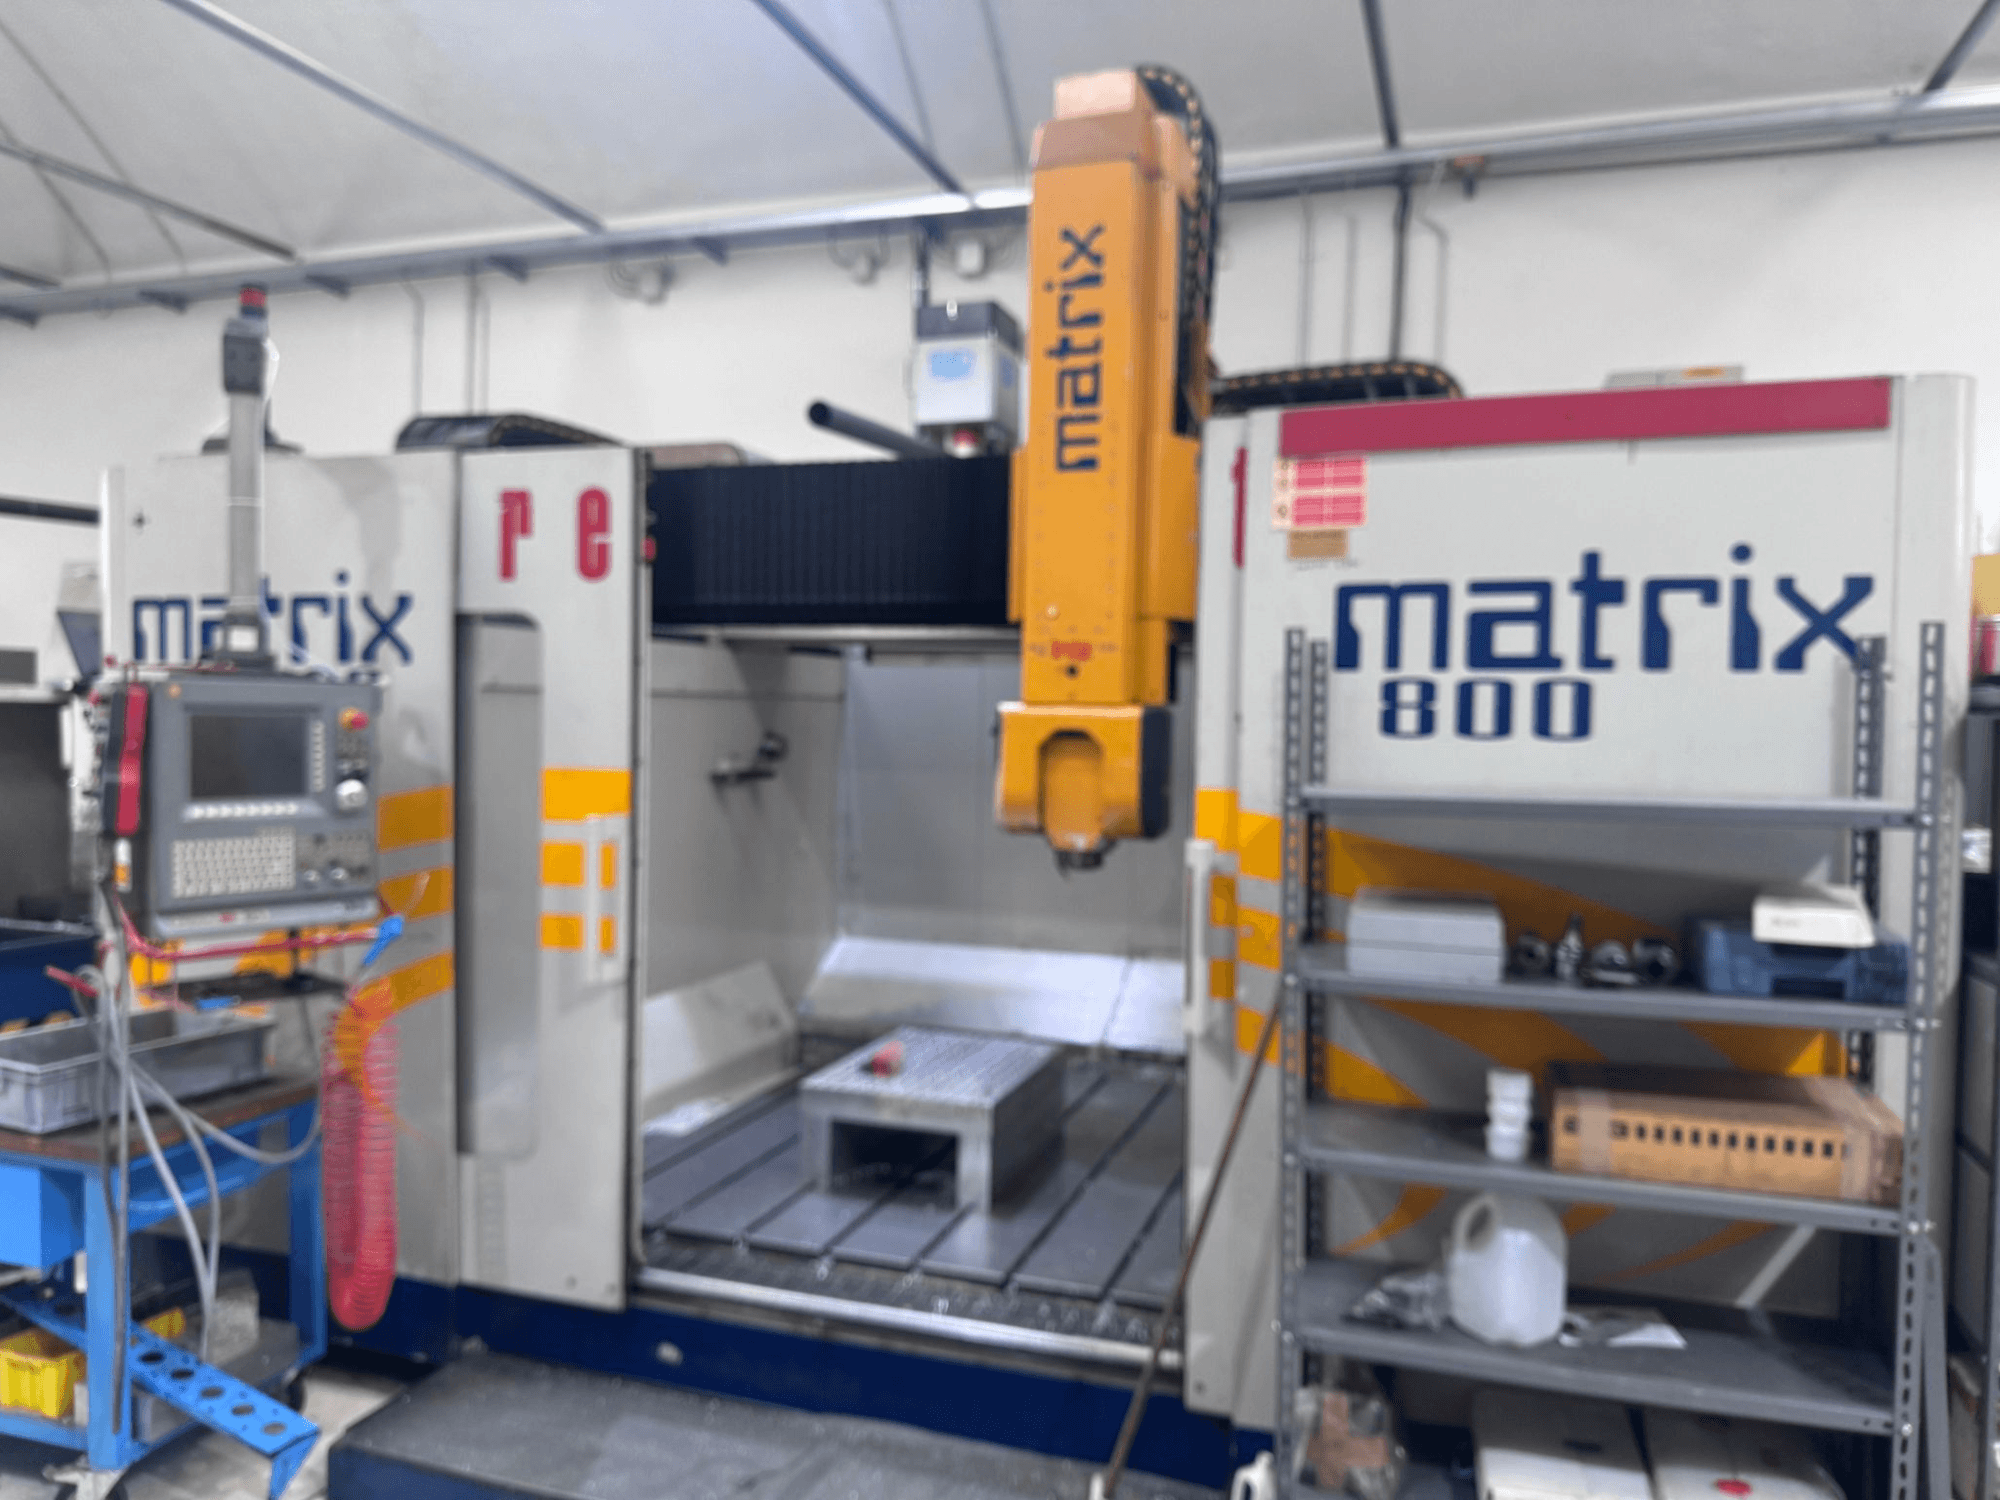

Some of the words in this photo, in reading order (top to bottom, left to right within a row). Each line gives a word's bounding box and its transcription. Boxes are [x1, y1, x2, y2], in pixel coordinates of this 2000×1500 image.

[1045, 224, 1104, 472] matrix
[1334, 543, 1874, 672] matrix
[1379, 677, 1594, 741] 800
